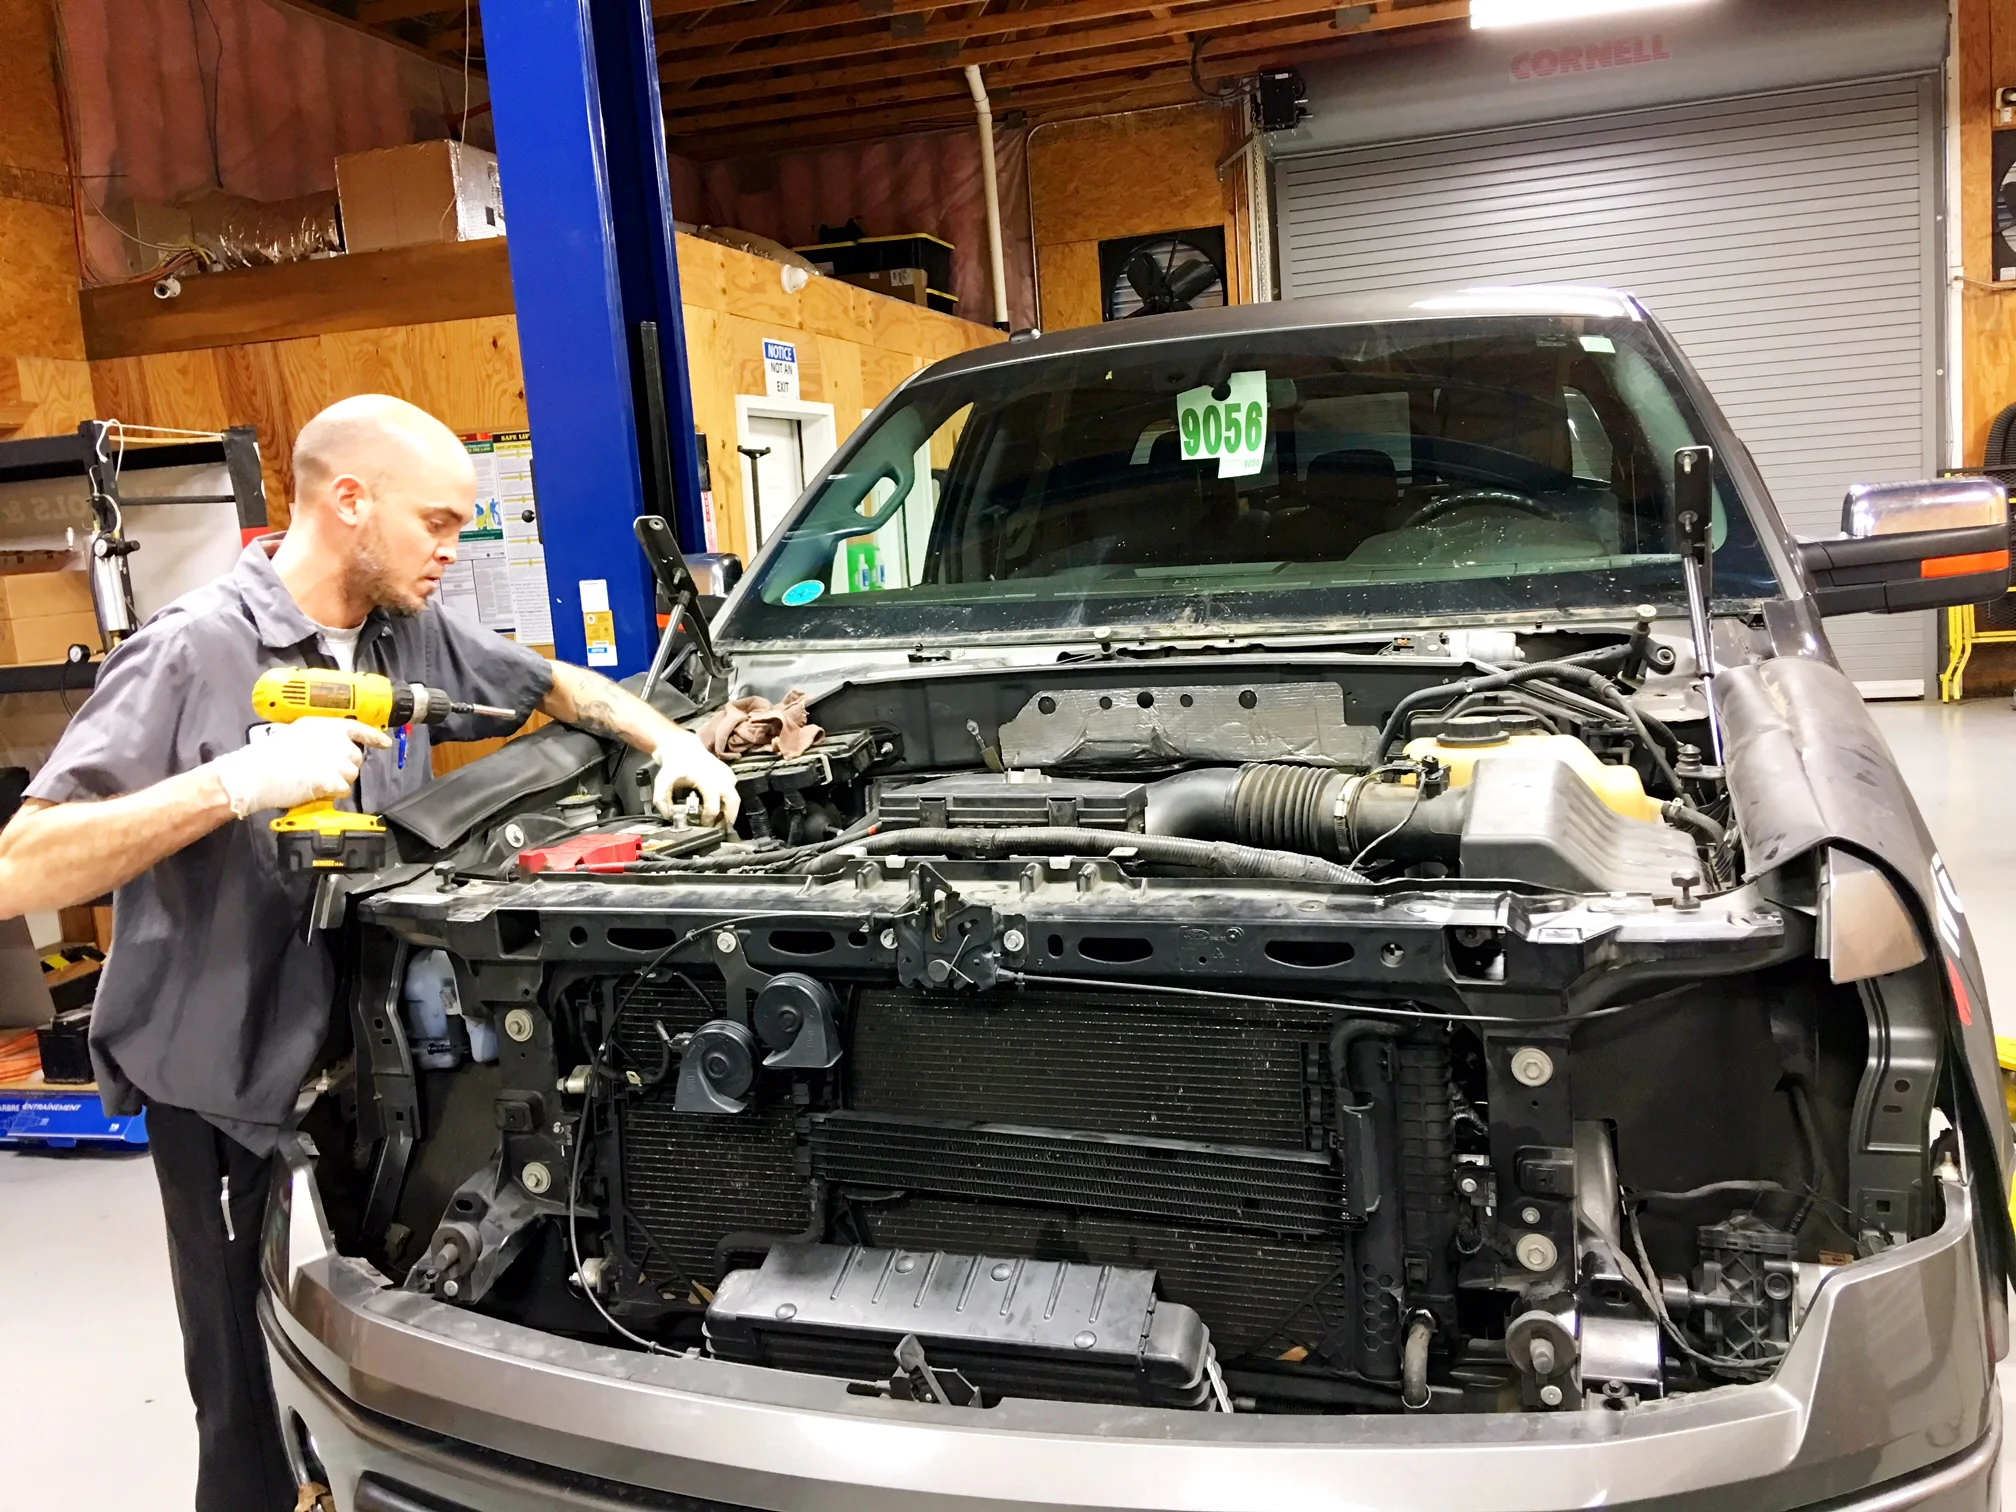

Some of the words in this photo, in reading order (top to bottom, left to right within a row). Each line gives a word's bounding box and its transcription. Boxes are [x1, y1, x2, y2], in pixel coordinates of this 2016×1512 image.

[1510, 33, 1671, 80] CORNELL
[767, 344, 792, 361] NOTICE
[770, 362, 782, 374] NOT
[784, 364, 793, 375] AN
[776, 381, 789, 392] EXIT
[1181, 400, 1263, 457] 9056
[501, 434, 517, 442] SAFE
[1243, 459, 1261, 468] 9056
